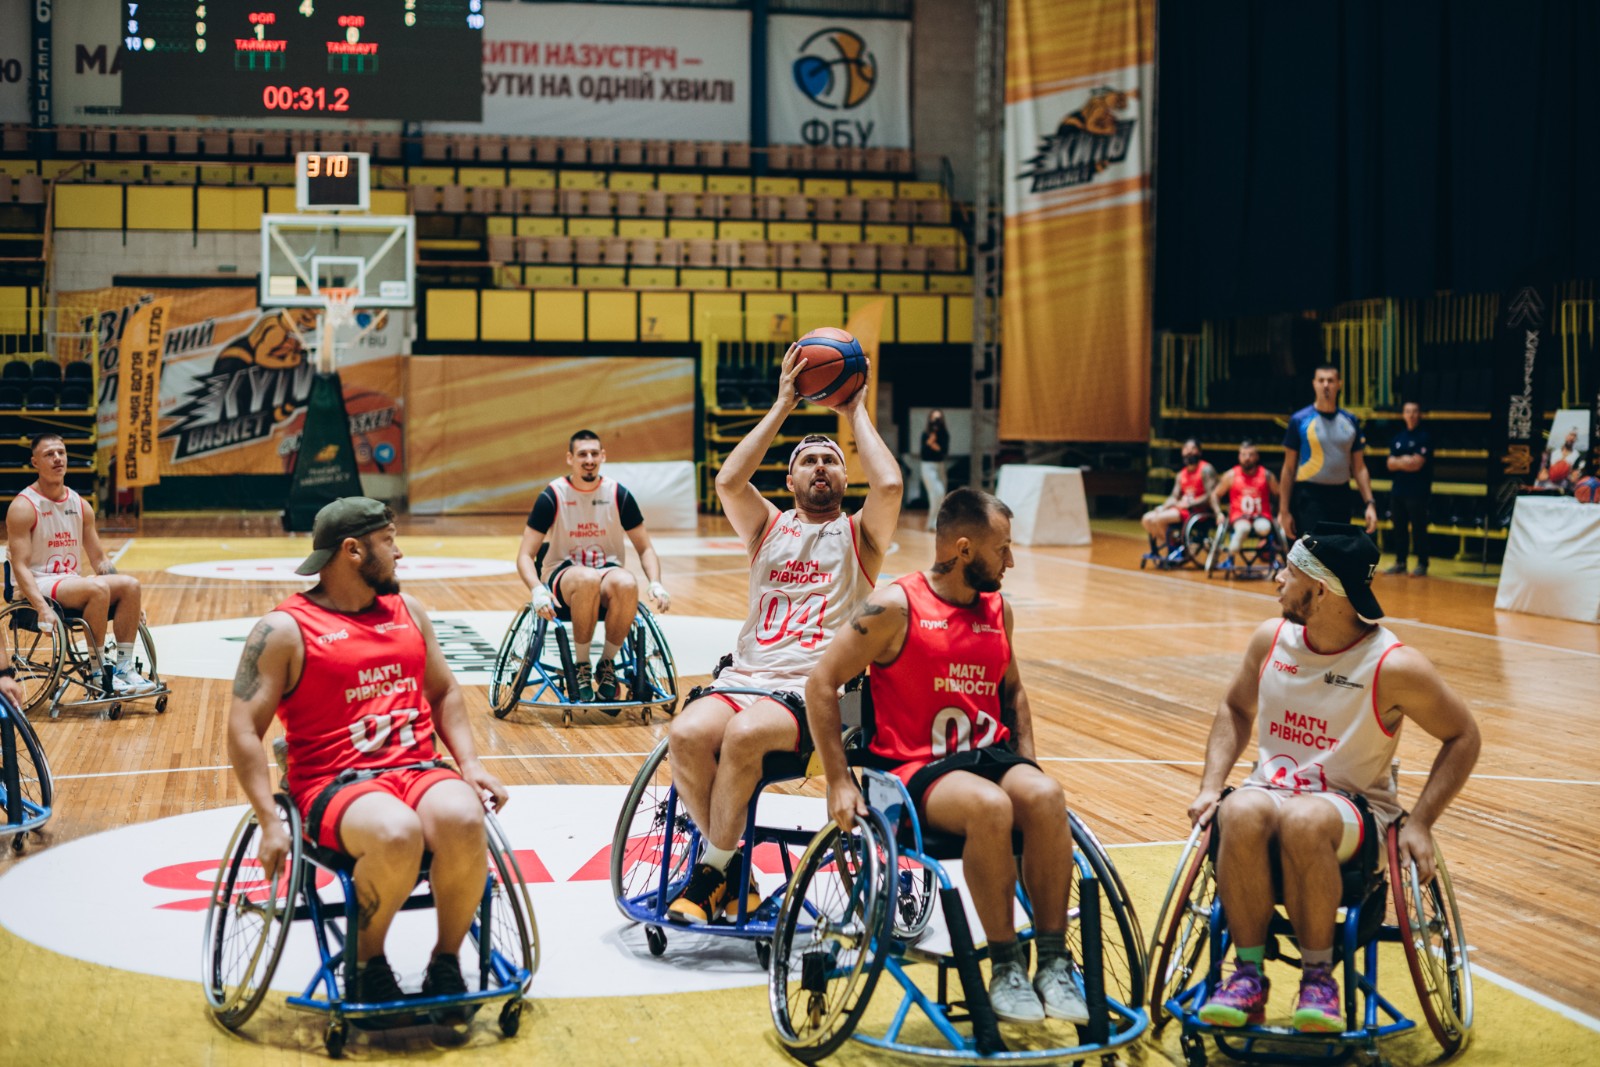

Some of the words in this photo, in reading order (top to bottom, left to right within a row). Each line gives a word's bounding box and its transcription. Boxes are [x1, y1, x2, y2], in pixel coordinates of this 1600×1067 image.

[37, 0, 51, 22] 6
[128, 3, 139, 17] 7
[196, 4, 207, 19] 4
[253, 23, 265, 41] 1
[125, 36, 142, 51] 10
[544, 41, 678, 70] НАЗУСТРІЧ
[264, 86, 349, 111] 00:31.2
[482, 72, 534, 97] УТИ
[541, 74, 573, 98] НА
[578, 73, 654, 103] ОДНІЙ
[659, 78, 734, 103] ХВИЛІ
[801, 117, 875, 149] ФБУ
[769, 569, 833, 584] РІВНОСТІ
[785, 560, 819, 573] МАТЧ
[756, 589, 828, 650] 04
[358, 663, 402, 685] МАТЧ
[949, 663, 986, 680] МАТЧ
[345, 677, 418, 703] РІВНОСТІ
[934, 677, 997, 697] РІВНОСТІ
[1284, 710, 1328, 734] МАТЧ
